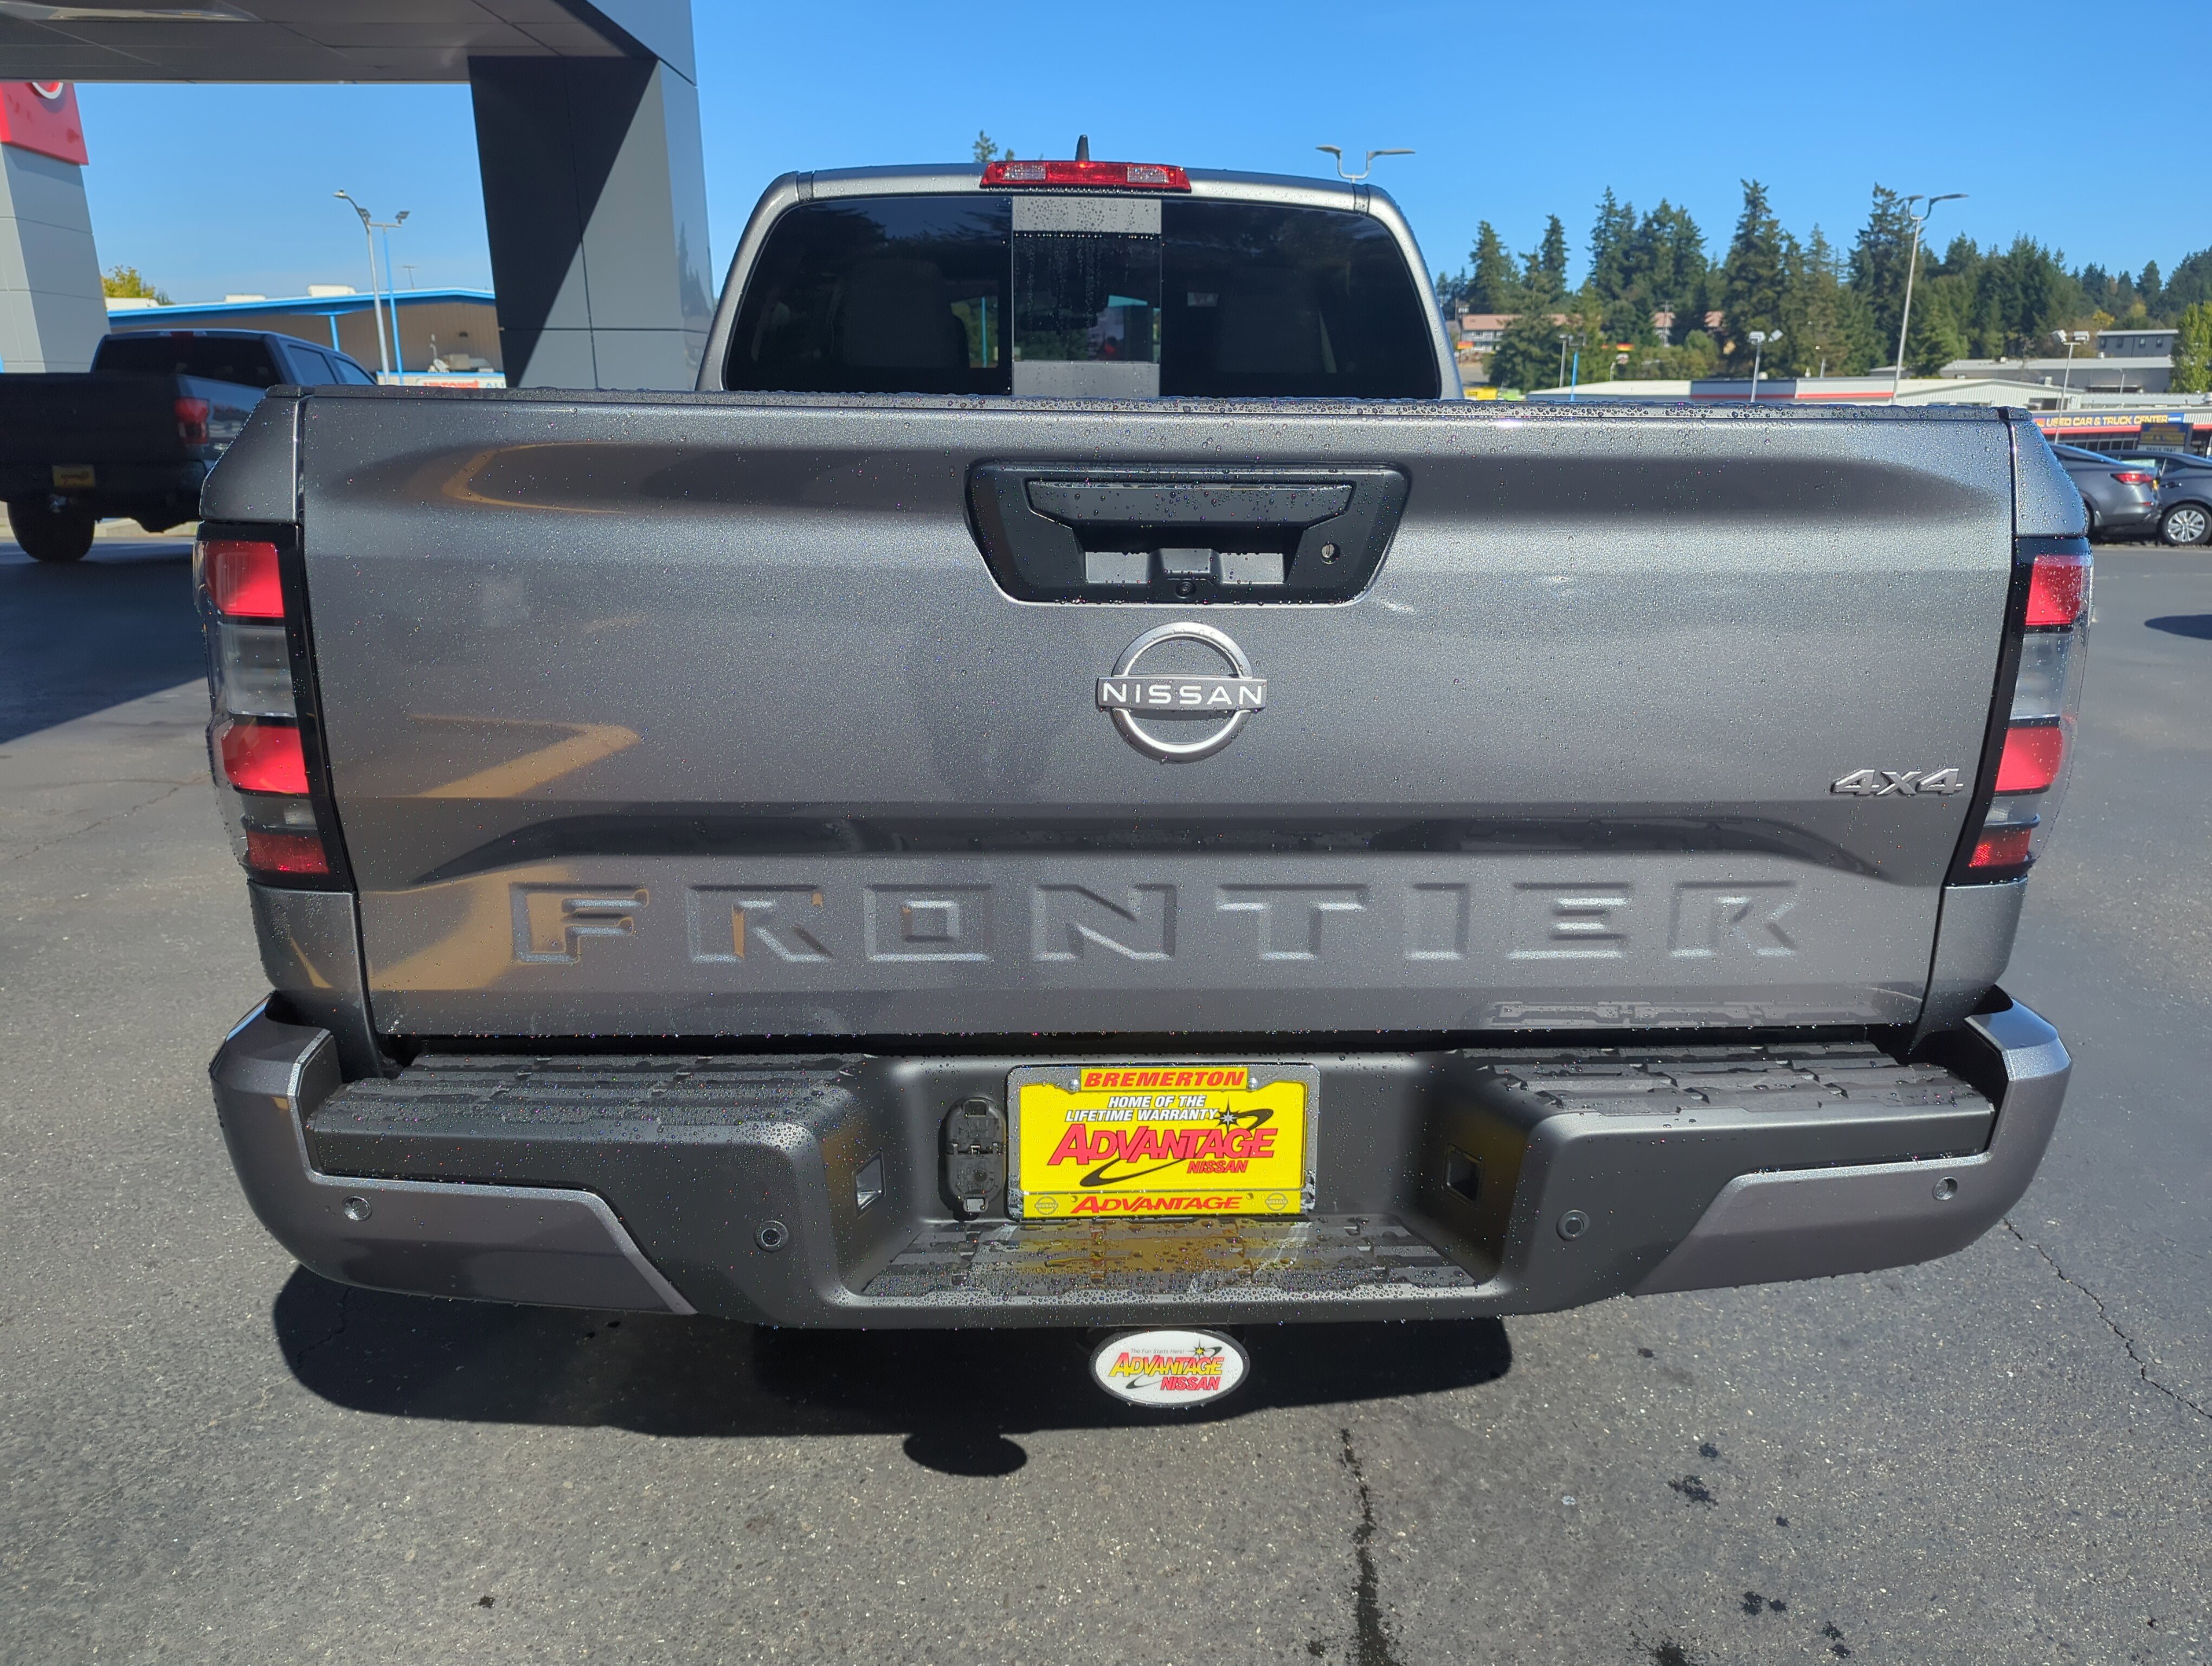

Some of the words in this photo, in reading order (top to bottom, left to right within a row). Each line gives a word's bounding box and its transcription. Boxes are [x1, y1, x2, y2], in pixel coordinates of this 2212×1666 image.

[2046, 416, 2072, 427] USED
[2073, 416, 2093, 426] CAR
[2093, 416, 2101, 426] &
[2102, 415, 2132, 426] TRUCK
[2133, 415, 2169, 425] CENTER
[1103, 682, 1262, 705] NISSAN
[510, 882, 1798, 963] FRONTIER
[1084, 1071, 1245, 1087] BREMERTON
[1108, 1096, 1152, 1108] HOME
[1155, 1095, 1175, 1107] OF
[1178, 1095, 1207, 1107] THE
[1065, 1109, 1134, 1122] LIFETIME
[1136, 1108, 1220, 1121] WARRANTY
[1047, 1123, 1278, 1165] ADVANTAGE
[1187, 1159, 1249, 1174] NISSAN
[1070, 1196, 1243, 1214] ADVANTAGE
[1108, 1352, 1225, 1377] ADVANTAGE
[1160, 1376, 1221, 1391] NISSAN
